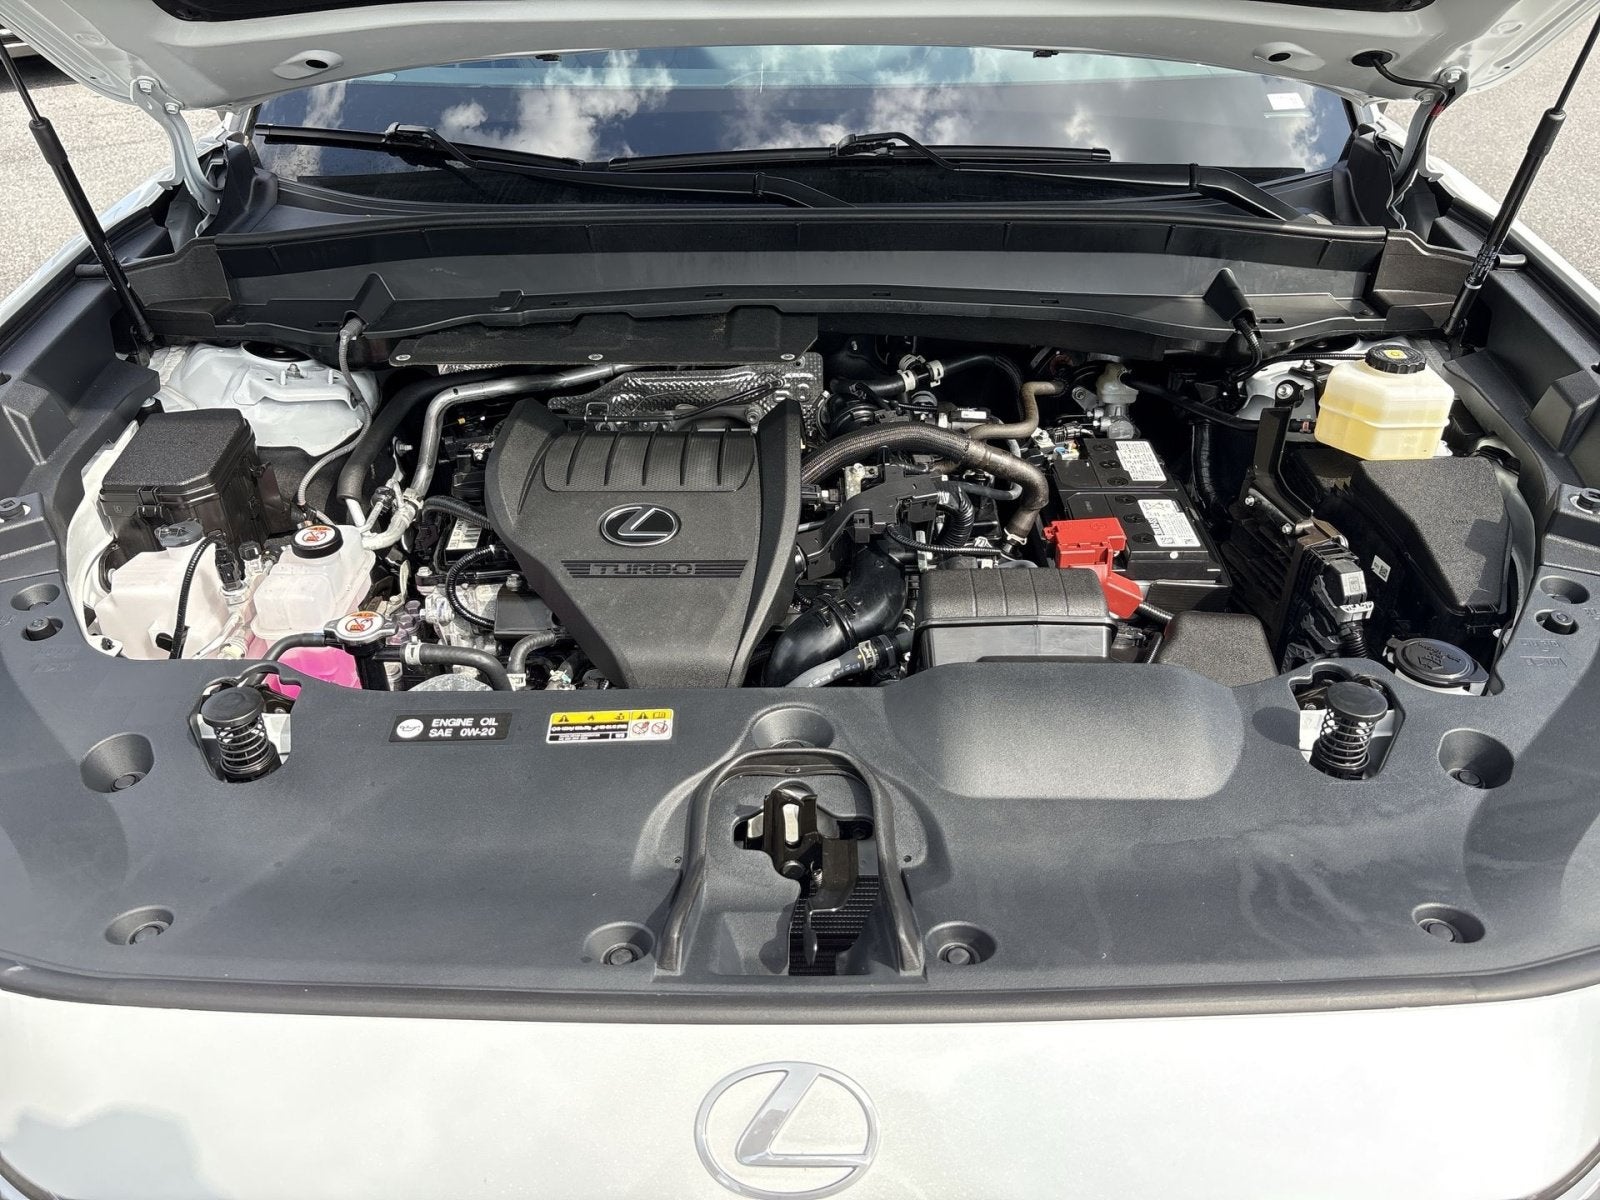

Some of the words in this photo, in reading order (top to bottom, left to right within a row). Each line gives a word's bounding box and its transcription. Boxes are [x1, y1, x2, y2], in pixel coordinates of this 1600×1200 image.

[593, 563, 693, 575] TURBO
[431, 717, 474, 728] ENGINE
[480, 717, 499, 726] OIL
[428, 728, 453, 738] SAE
[459, 727, 496, 737] 0W-20
